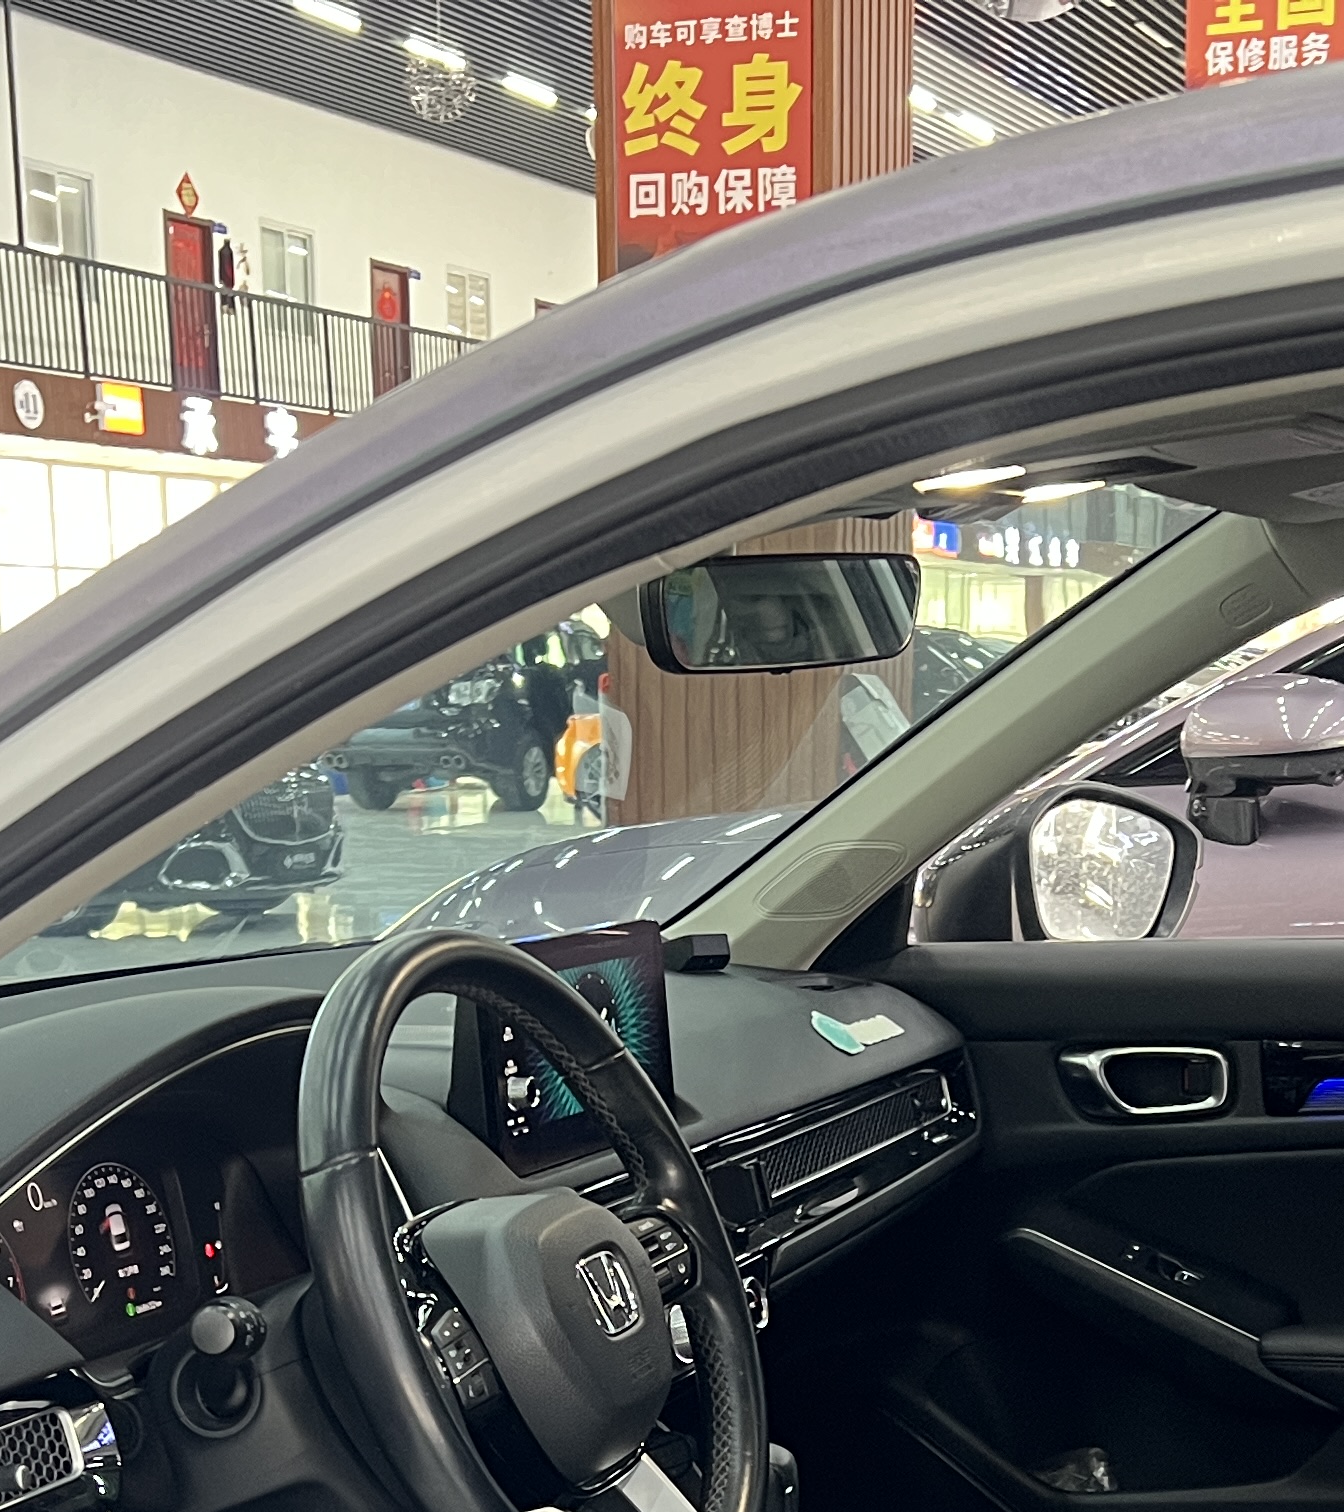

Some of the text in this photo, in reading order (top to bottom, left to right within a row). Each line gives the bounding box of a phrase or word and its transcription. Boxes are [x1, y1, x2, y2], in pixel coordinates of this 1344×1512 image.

[623, 10, 800, 50] 购车可享查博士
[1205, 32, 1331, 76] 保修服务
[622, 53, 803, 156] 终身
[629, 164, 798, 218] 回购保障
[27, 1182, 43, 1211] 0
